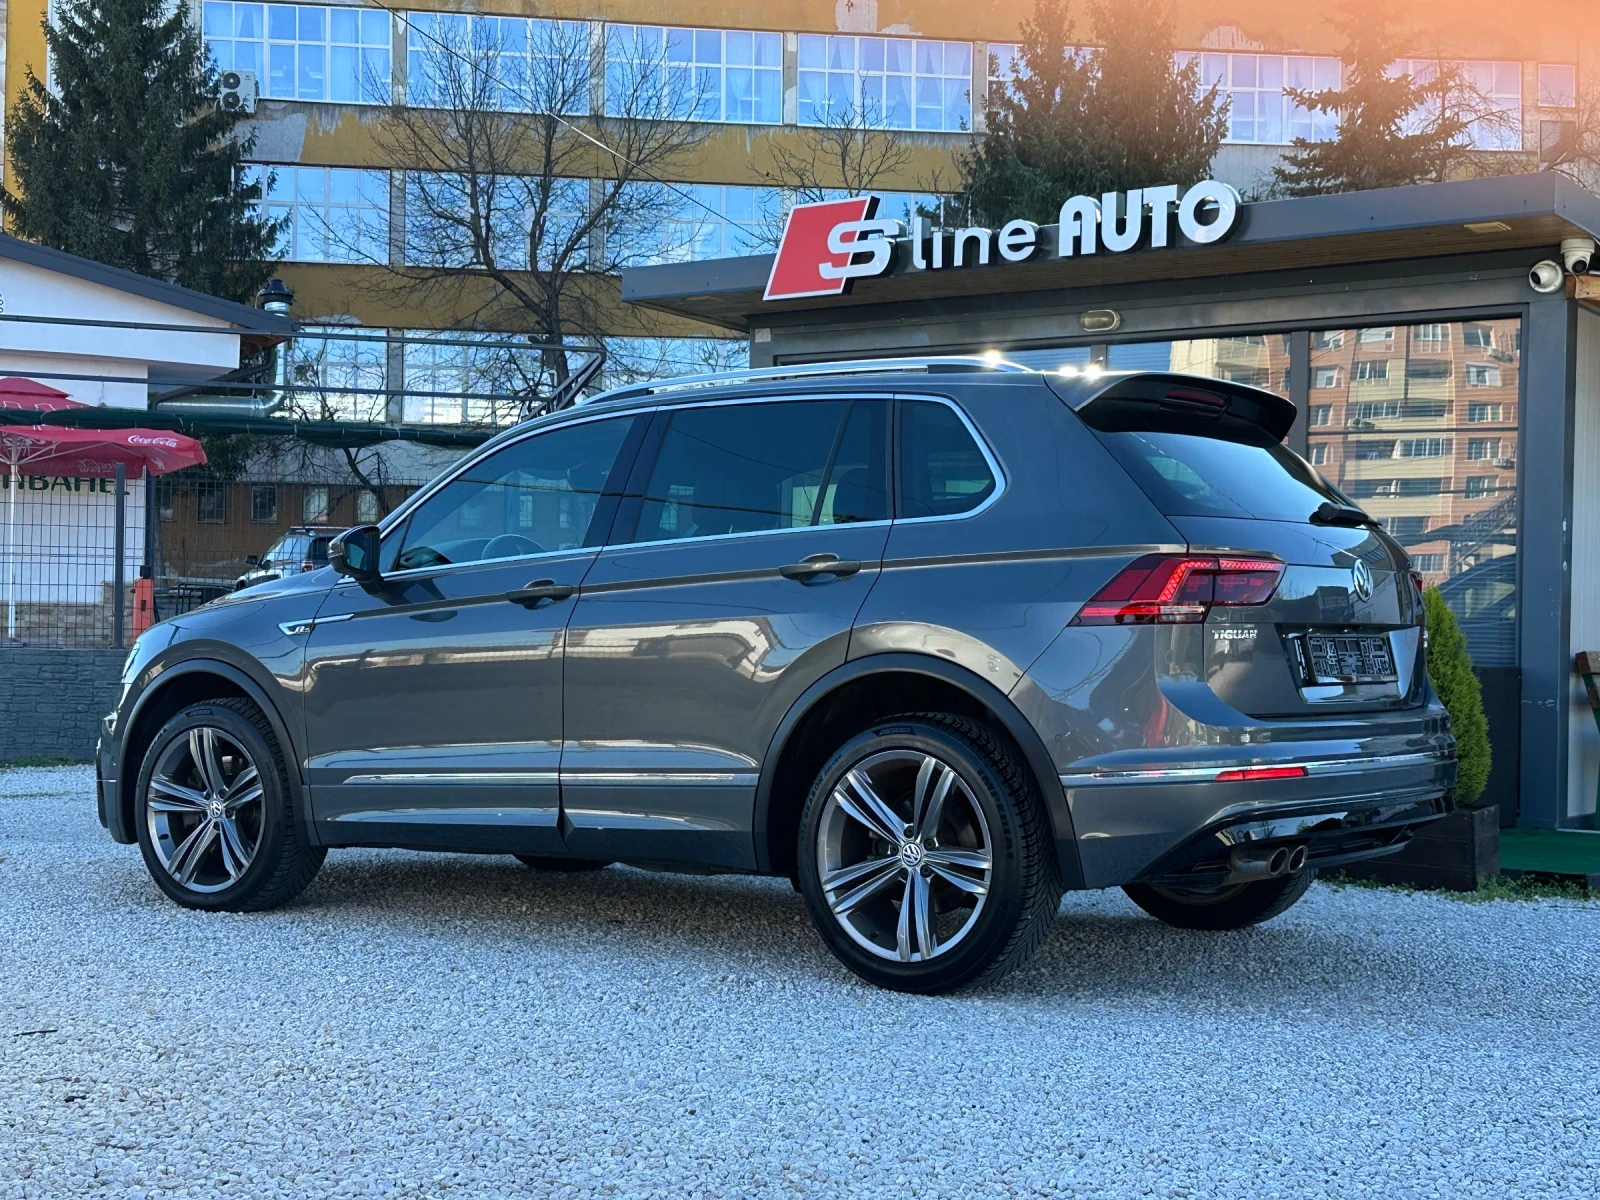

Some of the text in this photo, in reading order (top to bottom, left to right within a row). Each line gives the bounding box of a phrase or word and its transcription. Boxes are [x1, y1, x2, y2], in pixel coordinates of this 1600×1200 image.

[912, 216, 1037, 270] line
[1058, 180, 1240, 257] AUTO
[1211, 629, 1258, 640] TIGUAN
